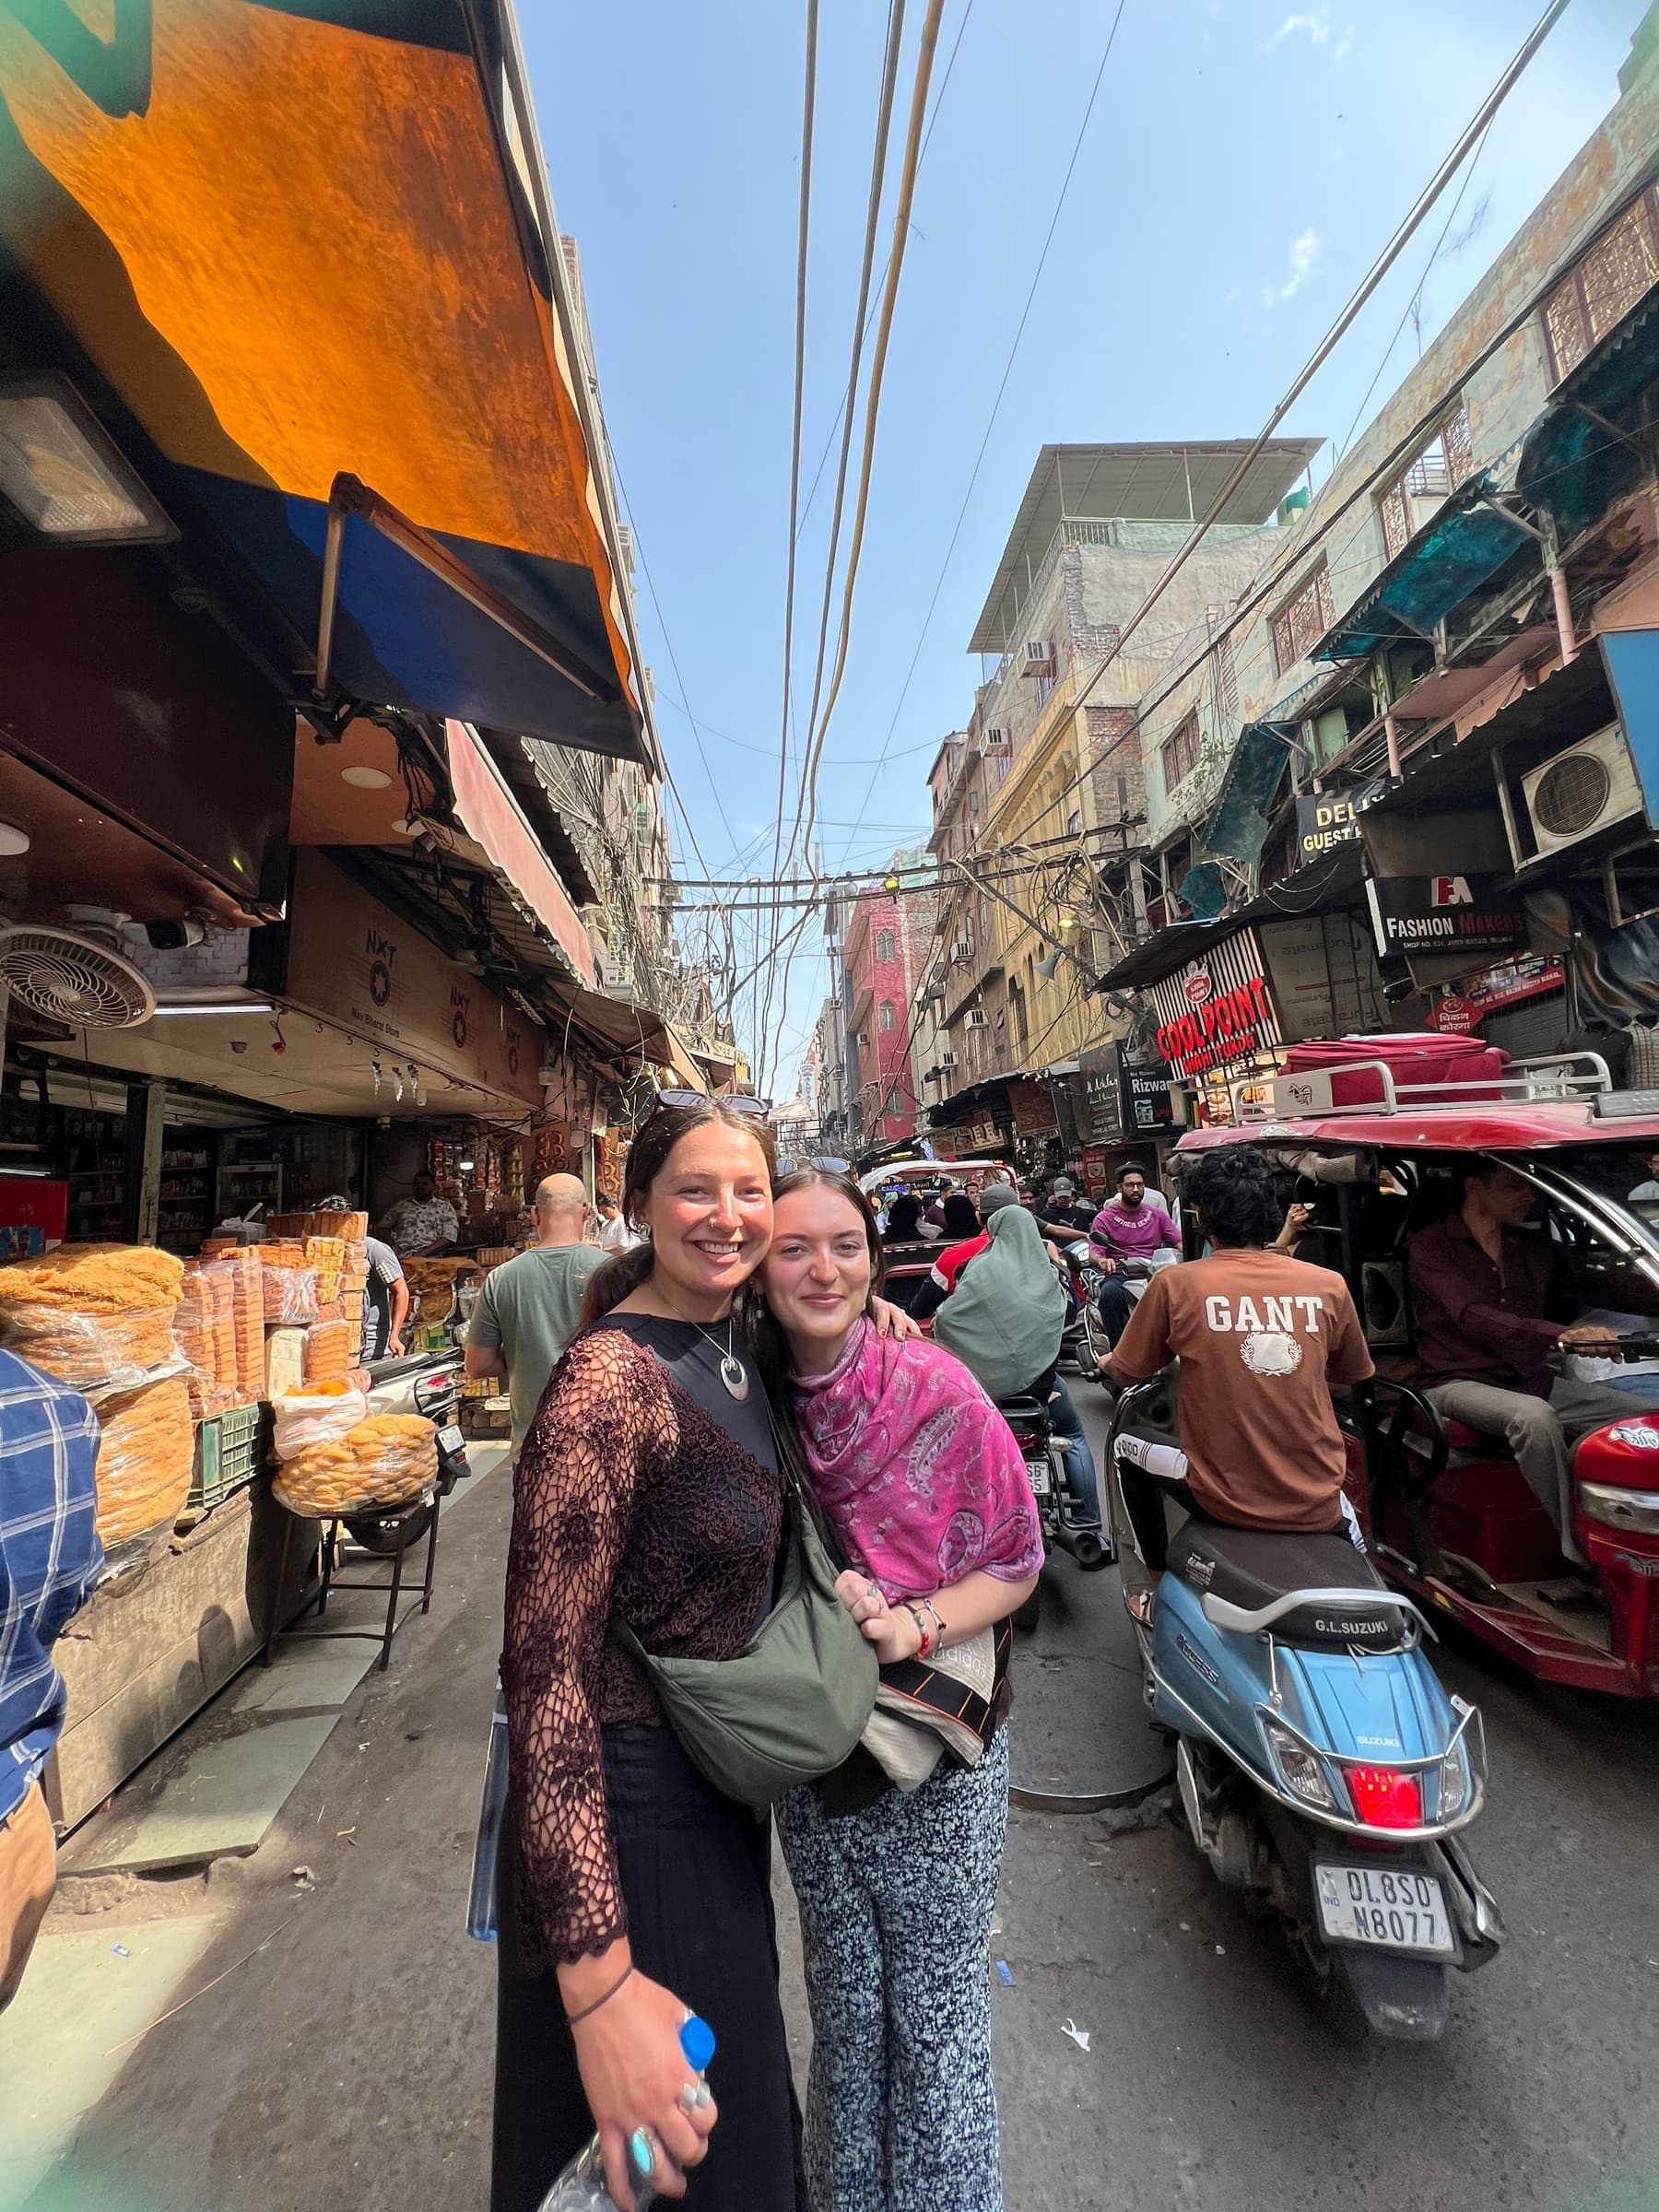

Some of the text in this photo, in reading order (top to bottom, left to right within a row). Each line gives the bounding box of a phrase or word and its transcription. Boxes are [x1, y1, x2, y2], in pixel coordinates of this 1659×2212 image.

[1303, 828, 1351, 852] GUEST
[1386, 917, 1454, 938] FASHION
[366, 928, 397, 968] NXT
[450, 986, 470, 1015] NXT
[1157, 977, 1267, 1062] COOL POINT
[1205, 1295, 1324, 1333] GANT
[1315, 1619, 1388, 1635] G.L.SUZUKI
[1356, 1735, 1402, 1747] SUZUKI
[1324, 1895, 1341, 1908] IND
[1353, 1906, 1435, 1945] N8077
